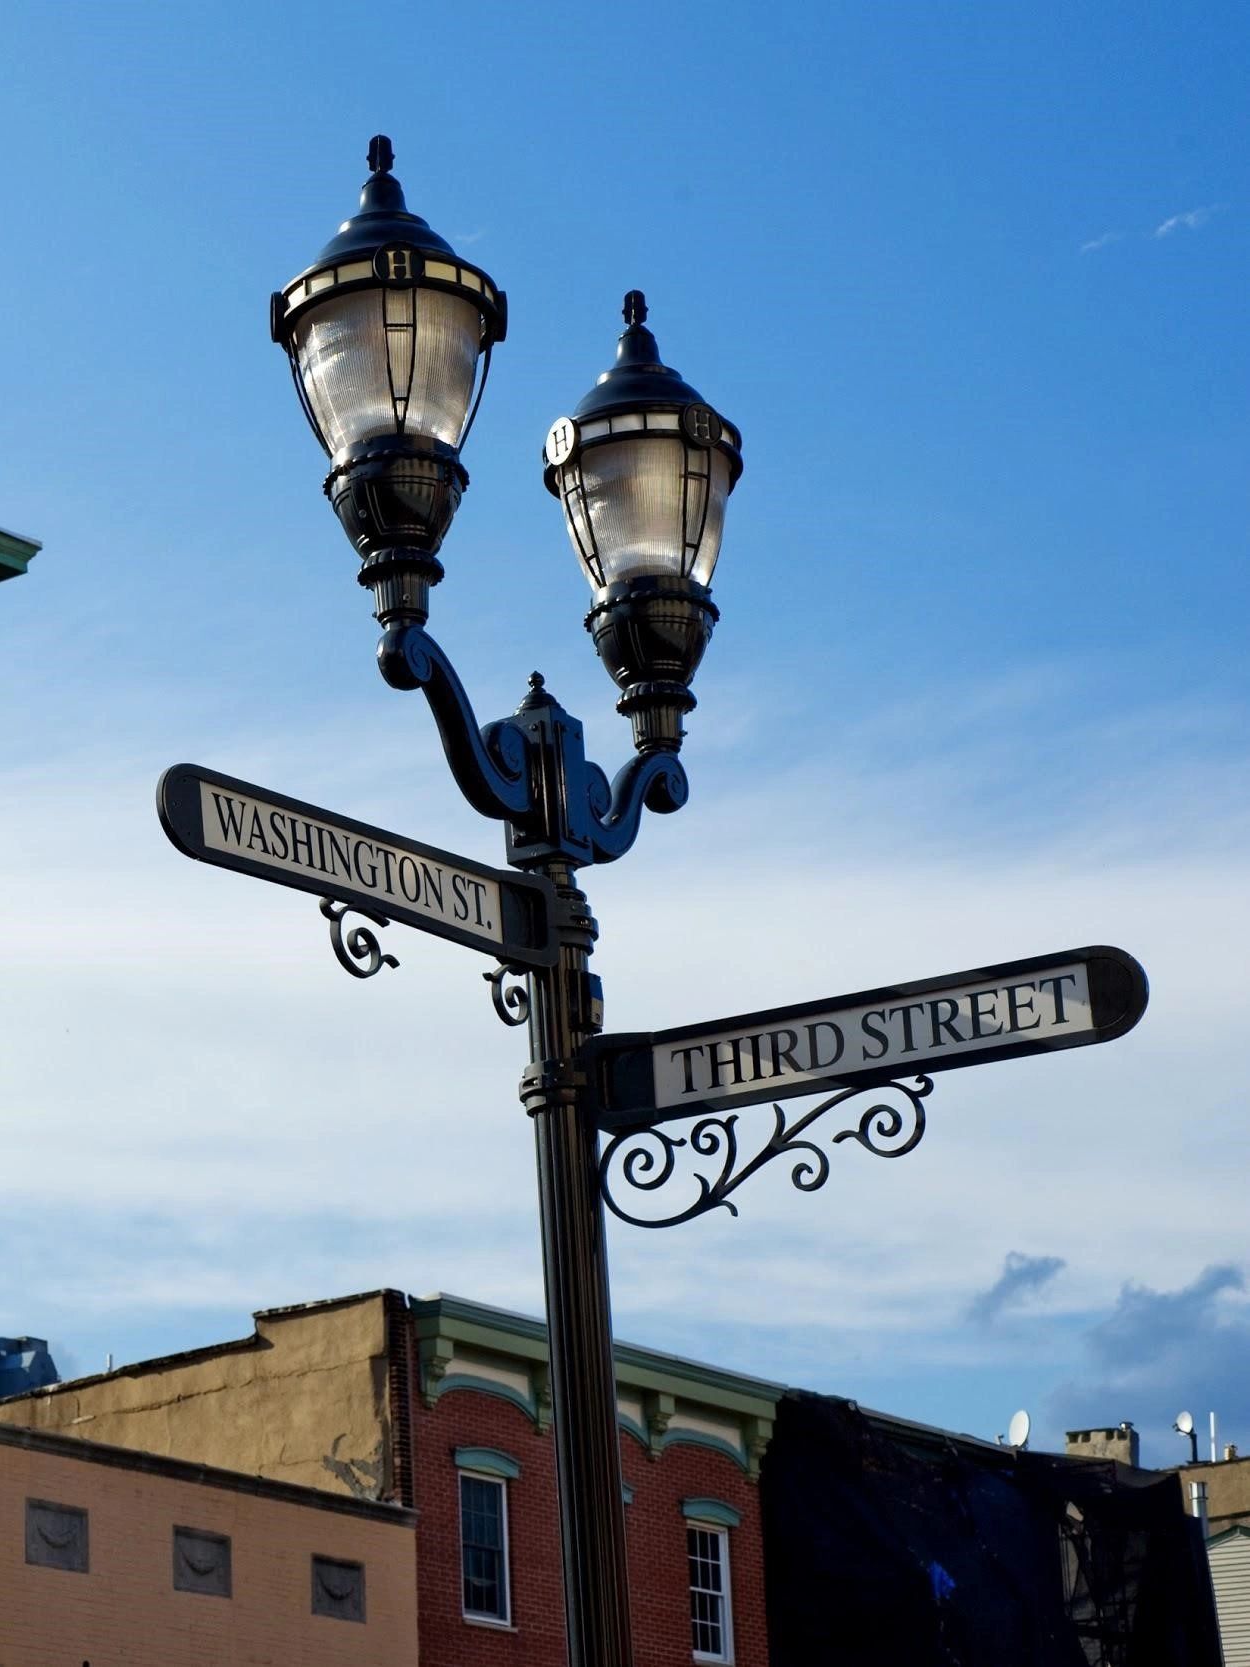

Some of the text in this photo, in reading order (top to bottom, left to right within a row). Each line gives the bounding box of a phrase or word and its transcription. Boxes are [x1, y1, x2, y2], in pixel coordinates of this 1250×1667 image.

[386, 250, 412, 279] H
[552, 424, 568, 457] H
[693, 409, 710, 439] H
[211, 792, 492, 930] WASHINGTON ST.
[670, 974, 1076, 1094] THIRD STREET
